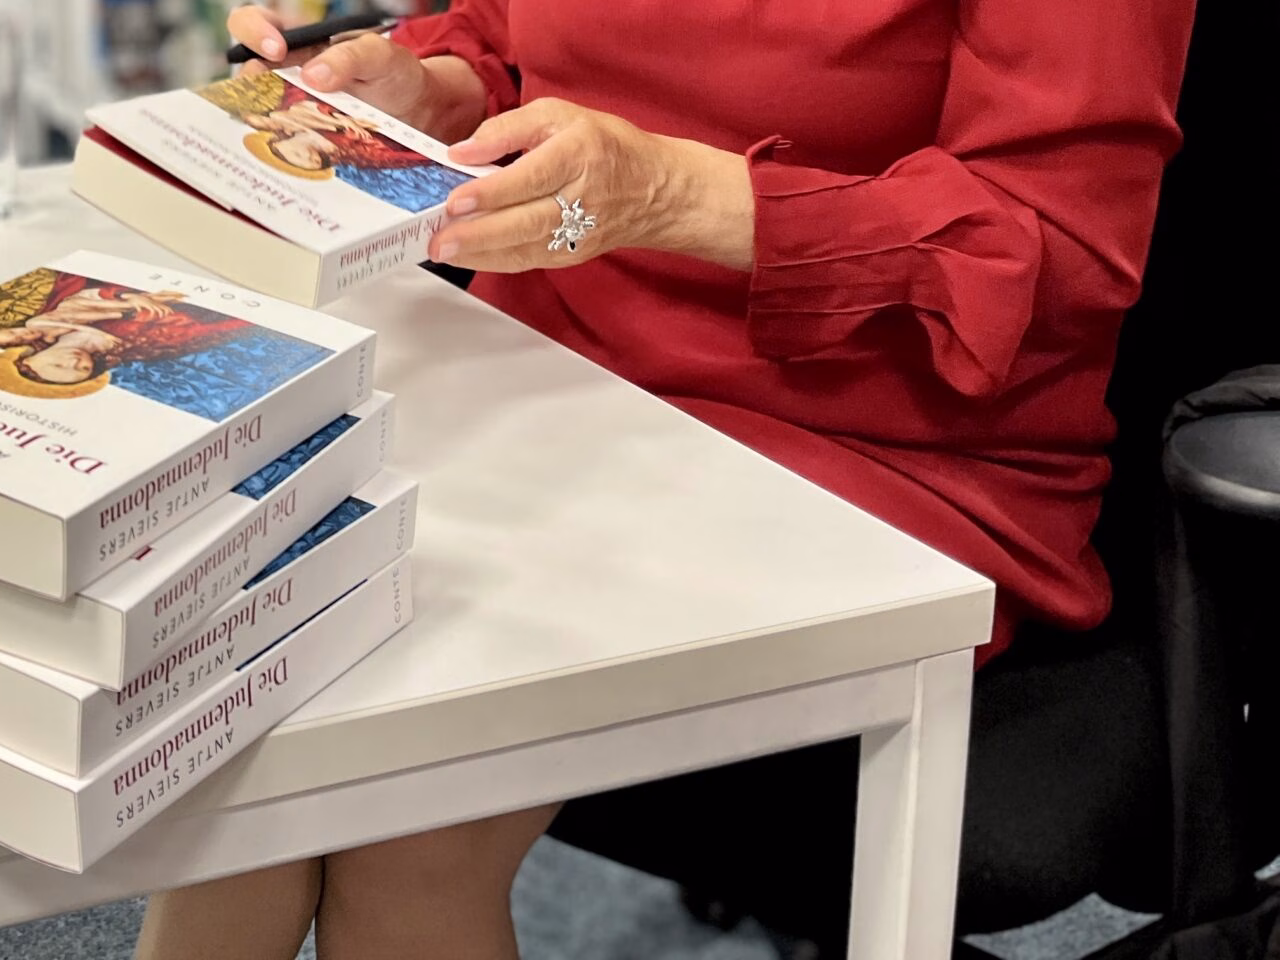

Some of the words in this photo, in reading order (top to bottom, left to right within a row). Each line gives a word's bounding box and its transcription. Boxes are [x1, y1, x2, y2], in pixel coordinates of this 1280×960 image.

[148, 273, 261, 308] CONTE
[356, 343, 367, 398] CONTE
[235, 414, 263, 448] Die
[45, 443, 107, 476] Die
[99, 428, 230, 530] Judenmadonna
[165, 477, 210, 518] ANTJE
[272, 488, 297, 523] Die
[99, 510, 159, 562] SIEVERS
[396, 497, 408, 551] CONTE
[153, 503, 269, 618] Judenmadonna
[211, 554, 250, 601] ANTJE
[152, 593, 205, 648] SIEVERS
[262, 577, 293, 612] Die
[392, 567, 402, 624] CONTE
[116, 594, 257, 706] Judenmadonna
[187, 644, 235, 687] ANTJE
[258, 656, 289, 693] Die
[115, 681, 180, 737] SIEVERS
[113, 677, 253, 796] Judenmadonna
[187, 727, 234, 775] ANTJE
[116, 768, 181, 828] SIEVERS
